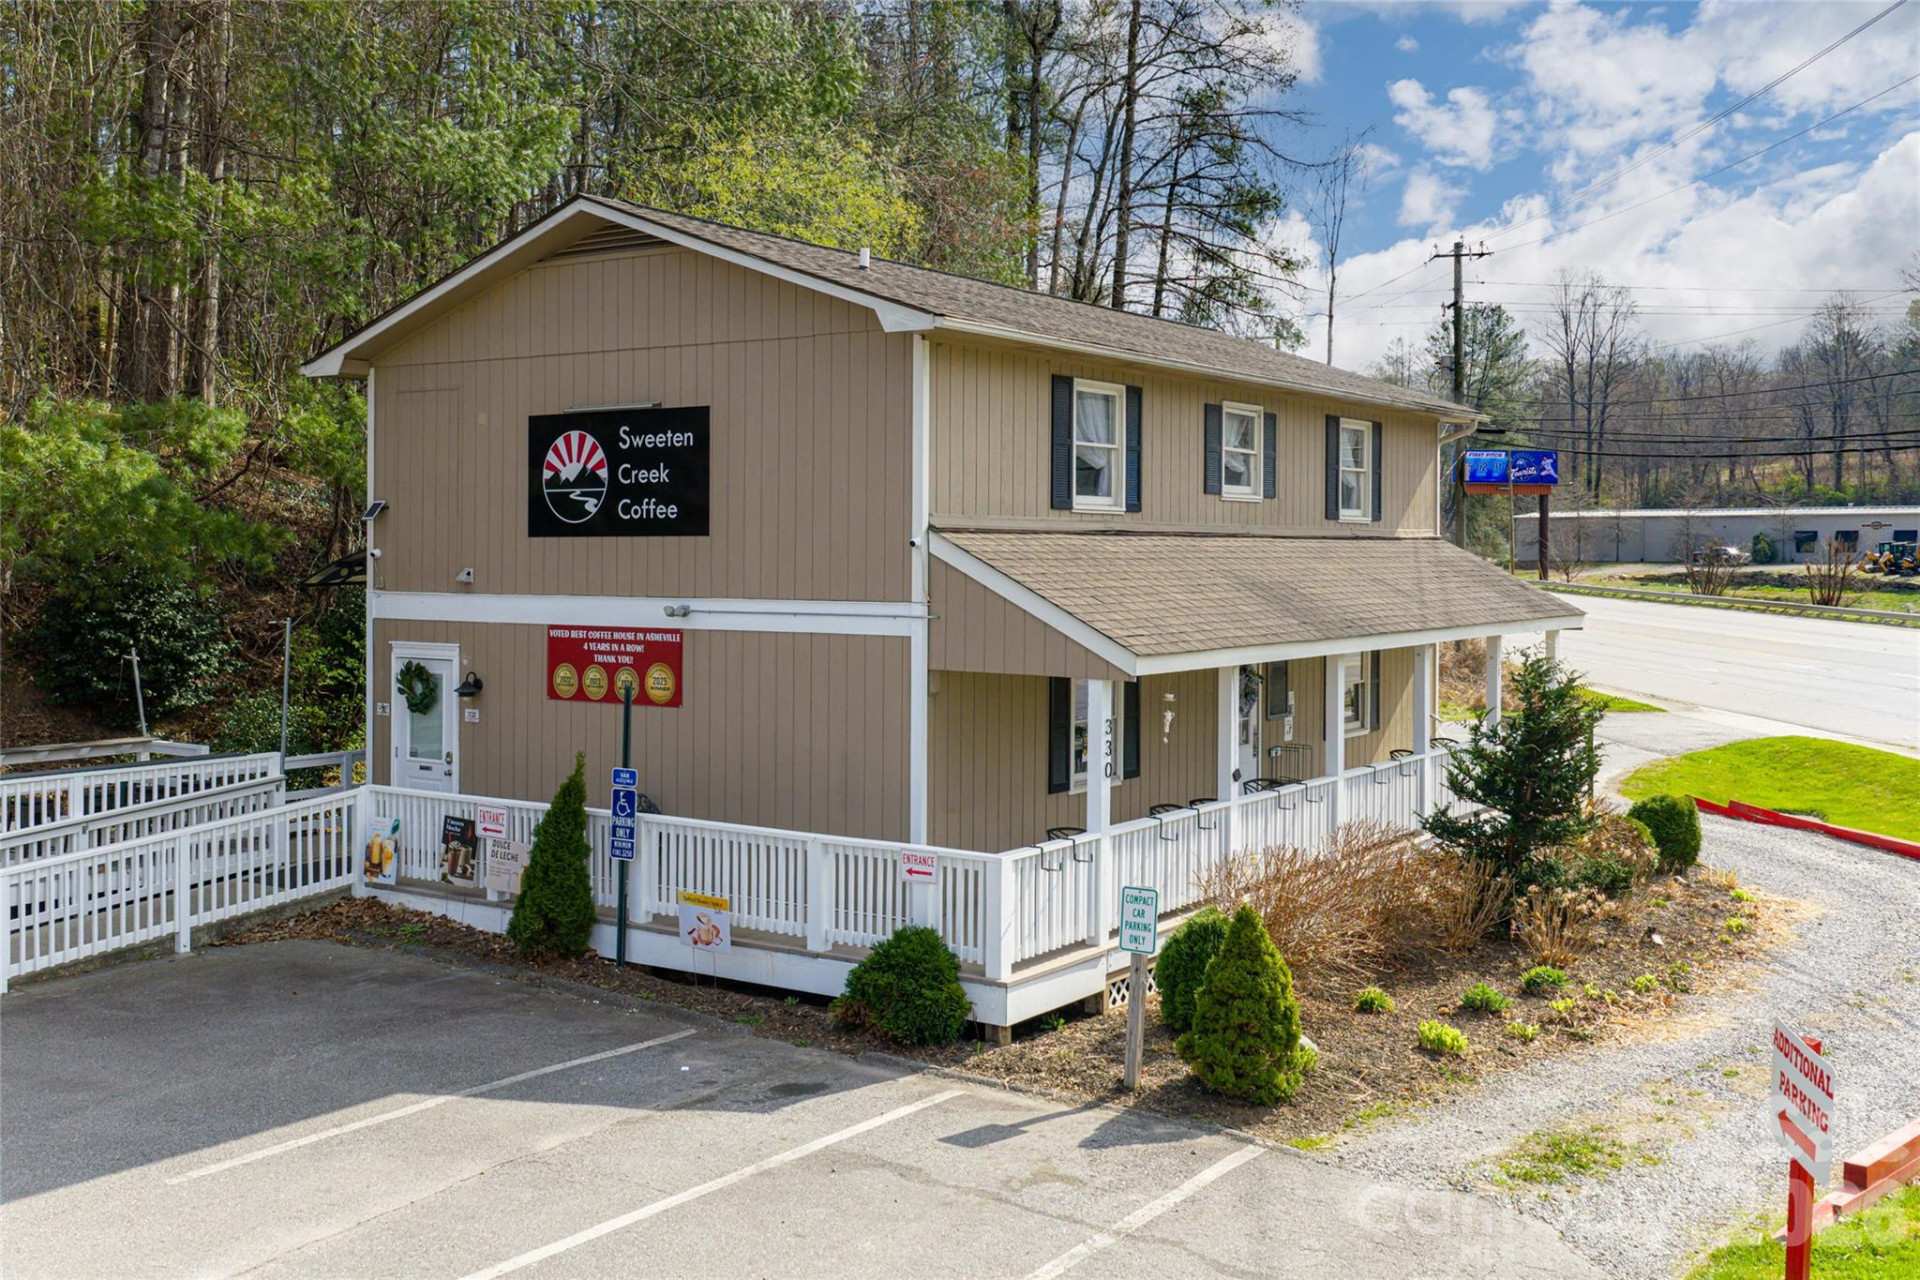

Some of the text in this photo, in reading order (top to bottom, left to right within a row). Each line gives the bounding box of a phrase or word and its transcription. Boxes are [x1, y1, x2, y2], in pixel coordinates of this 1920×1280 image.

[618, 426, 694, 449] Sweeten
[618, 462, 670, 484] Creek
[618, 498, 678, 519] Coffee
[550, 630, 680, 642] VOTED BEST COFFEE HOUSE IN ASHEVILLE
[589, 643, 610, 651] YEARS
[626, 644, 644, 652] ROW!
[594, 654, 633, 664] THANK YOU!
[653, 677, 668, 686] 2025
[480, 810, 505, 827] ENTRANCE
[612, 816, 635, 828] PARKING
[616, 827, 630, 838] ONLY
[492, 840, 511, 850] DULCE
[491, 850, 519, 862] DE LECHE
[903, 854, 935, 867] ENTRANCE
[1126, 894, 1154, 906] COMPACT
[1132, 908, 1145, 918] CAR
[1125, 921, 1152, 933] PARKING
[1129, 935, 1146, 945] ONLY
[1773, 1027, 1834, 1100] ADDITIONAL
[1779, 1071, 1829, 1134] PARKING
